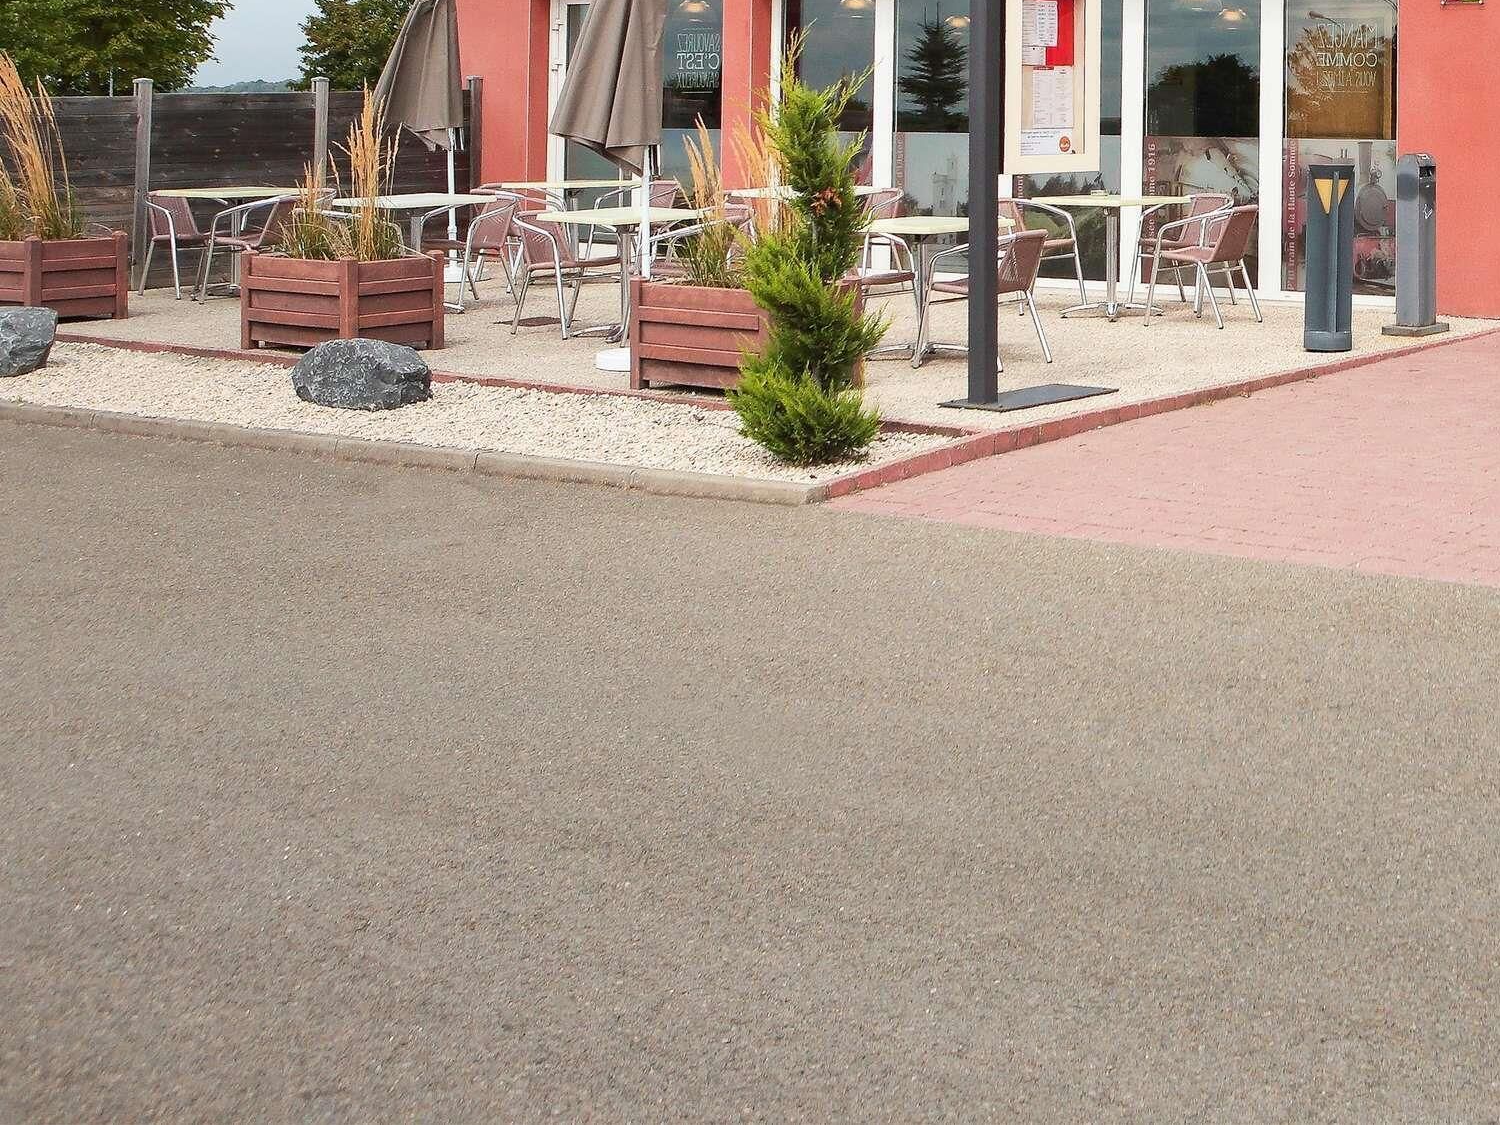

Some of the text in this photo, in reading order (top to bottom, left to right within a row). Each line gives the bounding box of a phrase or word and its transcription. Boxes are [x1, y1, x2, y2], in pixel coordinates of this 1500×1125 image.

[1147, 143, 1156, 172] 1916
[1287, 140, 1297, 178] Somme
[1287, 180, 1296, 211] Haute
[1287, 213, 1296, 224] la
[1287, 227, 1296, 239] de
[1287, 242, 1296, 266] train
